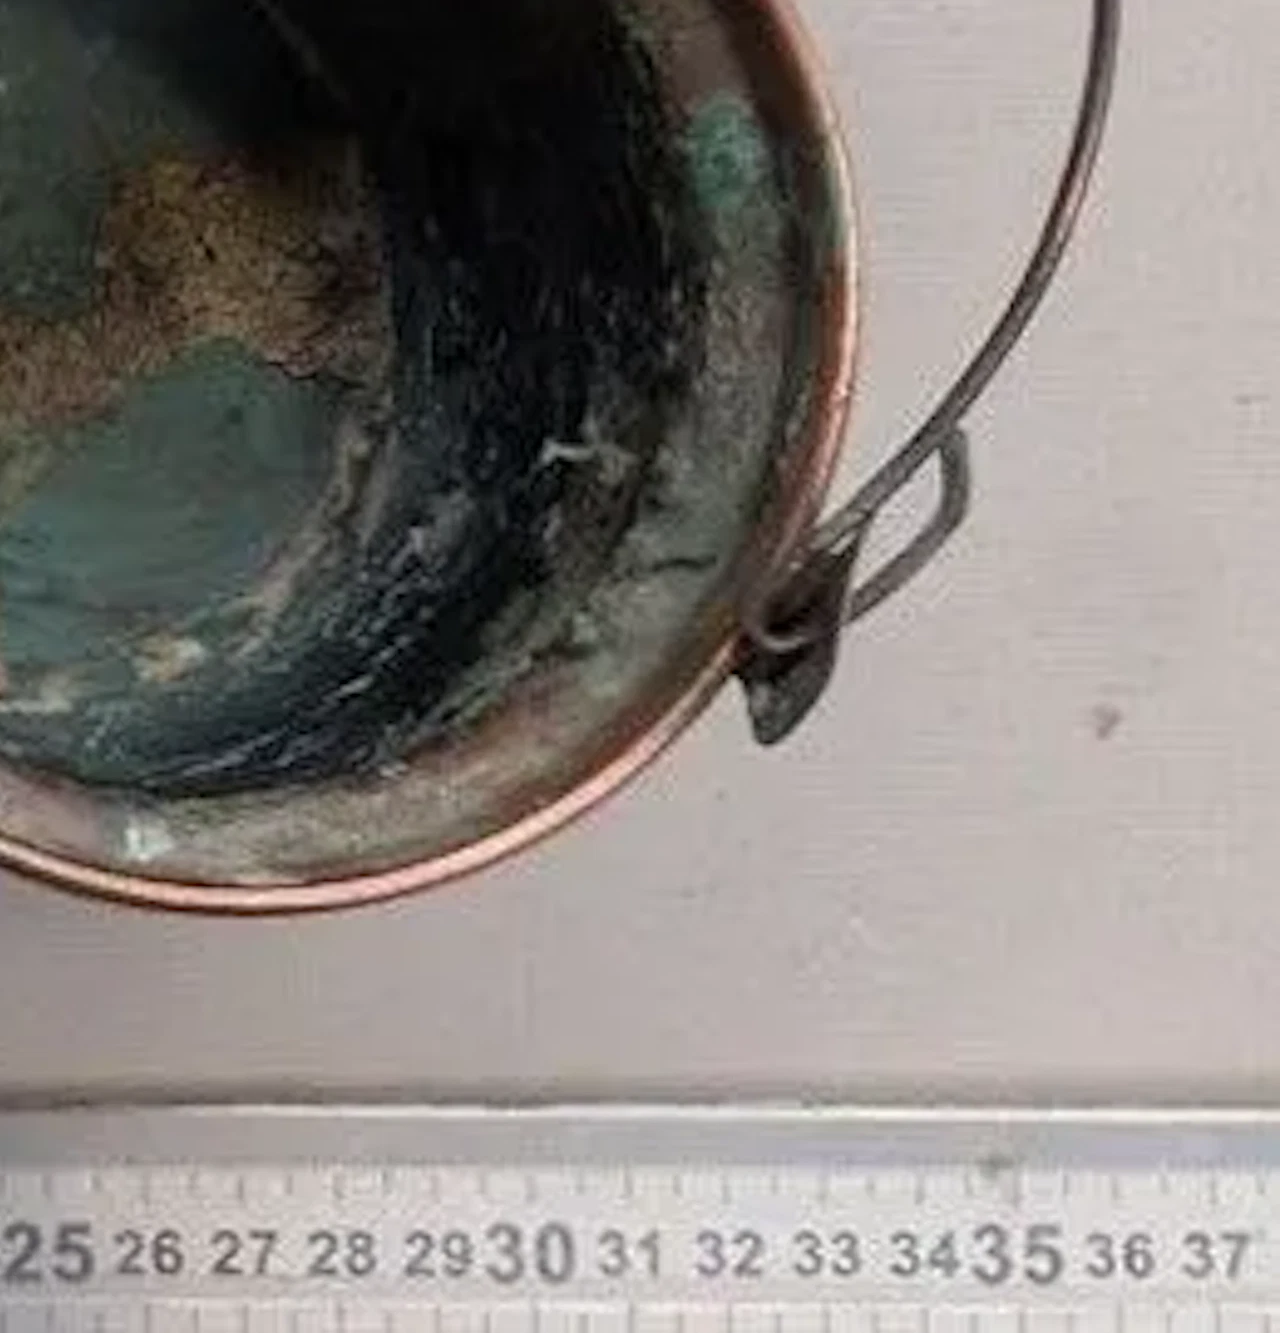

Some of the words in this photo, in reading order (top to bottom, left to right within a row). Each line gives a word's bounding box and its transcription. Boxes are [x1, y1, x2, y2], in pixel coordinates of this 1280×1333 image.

[2, 1220, 95, 1288] 25
[113, 1228, 186, 1277] 26
[209, 1228, 280, 1277] 27
[306, 1228, 378, 1278] 28
[403, 1229, 475, 1279] 29
[483, 1220, 577, 1288] 30
[597, 1228, 661, 1278] 31
[695, 1228, 766, 1279] 32
[792, 1229, 864, 1279] 33
[888, 1229, 961, 1279] 34
[971, 1222, 1066, 1288] 35
[1084, 1230, 1156, 1280] 36
[1181, 1230, 1253, 1281] 37
